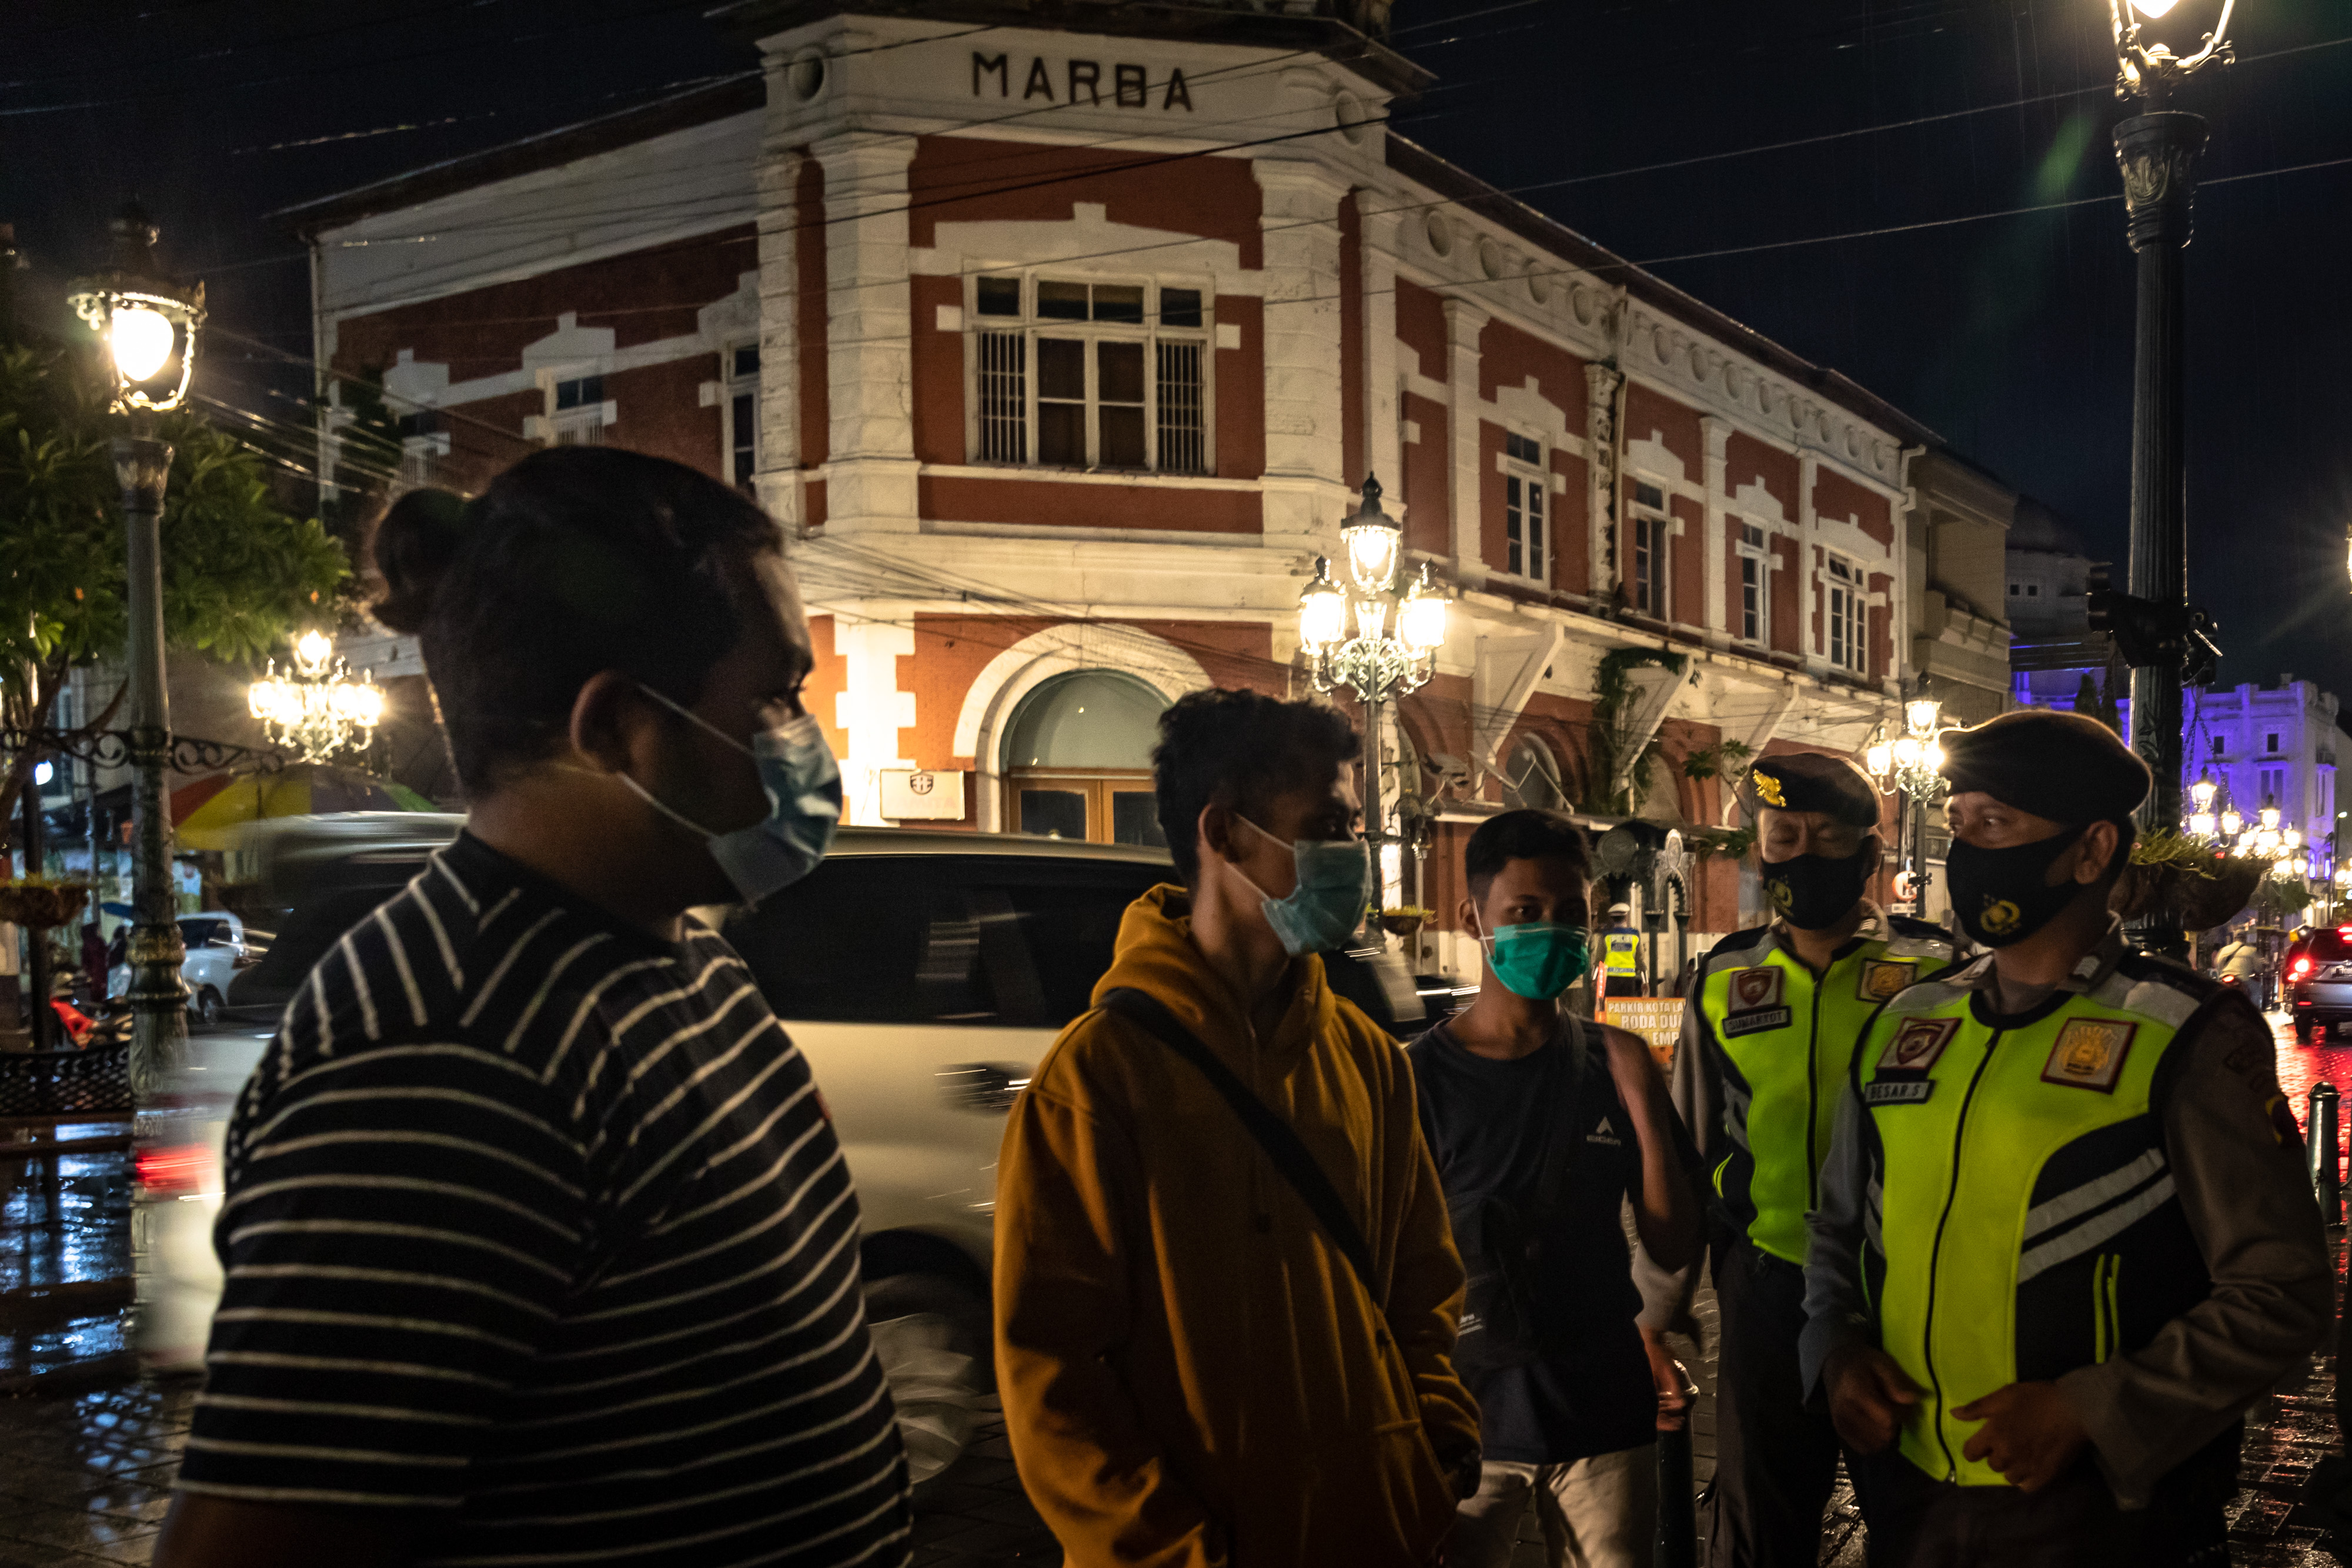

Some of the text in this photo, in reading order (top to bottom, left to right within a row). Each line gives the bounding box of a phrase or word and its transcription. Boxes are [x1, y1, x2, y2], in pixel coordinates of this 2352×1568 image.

[972, 51, 1194, 112] MARBA
[1608, 1001, 1685, 1014] PARKIR KOTA LA
[1621, 1014, 1657, 1029] RODA
